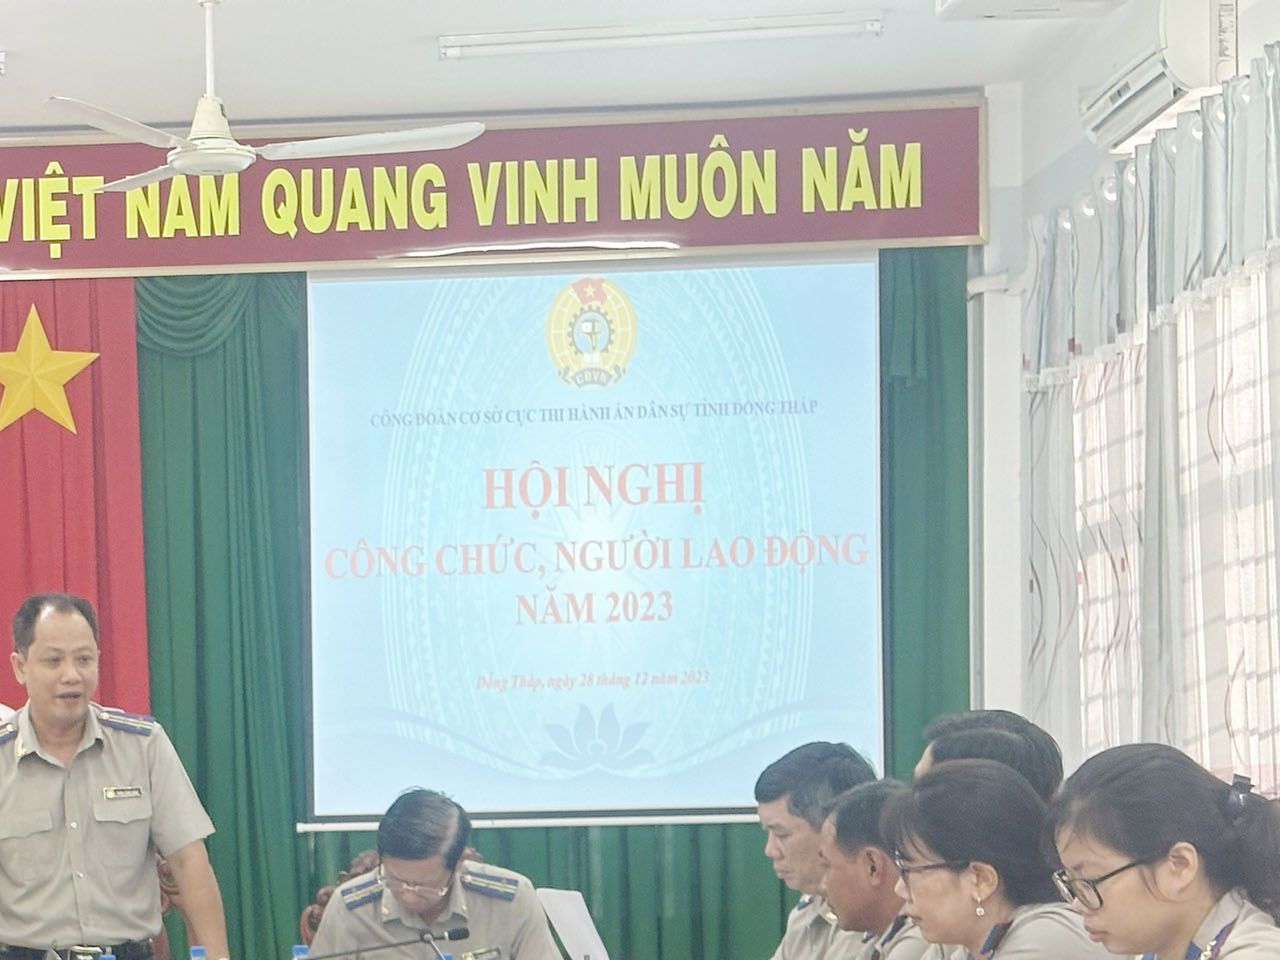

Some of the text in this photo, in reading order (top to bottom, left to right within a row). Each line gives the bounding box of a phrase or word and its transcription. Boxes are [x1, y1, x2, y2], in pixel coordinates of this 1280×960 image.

[125, 172, 239, 239] NAM
[261, 162, 448, 239] QUANG
[467, 156, 598, 227] VINH
[618, 134, 778, 222] MUÔN
[802, 127, 922, 214] NĂM
[370, 408, 412, 428] CÔNG
[459, 409, 482, 425] CƠ
[505, 408, 536, 426] CỤC
[539, 408, 564, 422] THI
[569, 403, 611, 421] HÀNH
[637, 400, 668, 419] DÂN
[670, 402, 689, 421] SỰ
[779, 396, 819, 414] THÁP
[482, 460, 707, 519] HỘI NGHỊ
[324, 529, 869, 580] CÔNG CHỨC, NGƯỜI LAO ĐỘNG
[515, 584, 673, 625] NĂM 2023
